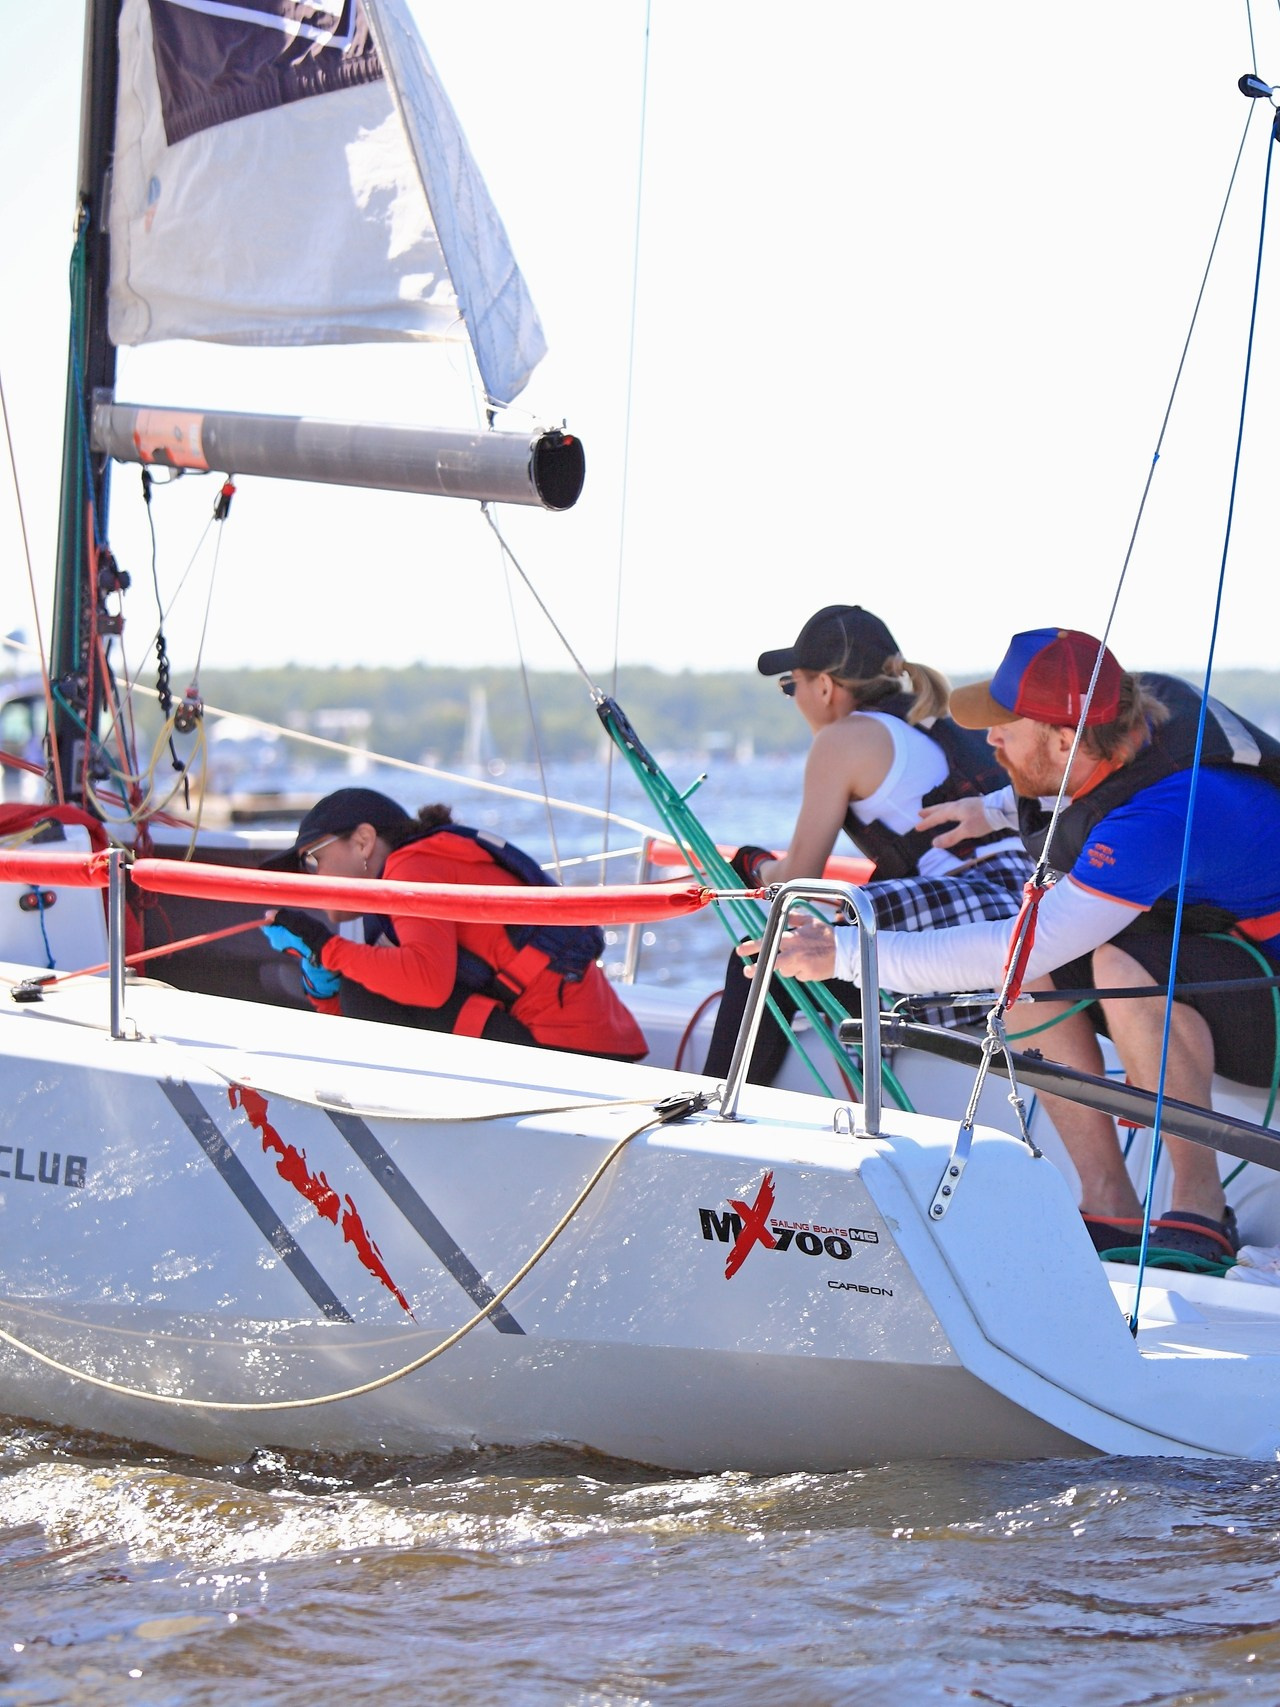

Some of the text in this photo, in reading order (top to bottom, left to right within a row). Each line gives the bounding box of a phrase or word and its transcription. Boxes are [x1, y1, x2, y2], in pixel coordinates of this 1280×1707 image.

[770, 1219, 848, 1237] SAILING BOATS
[827, 1280, 893, 1297] CARBON
